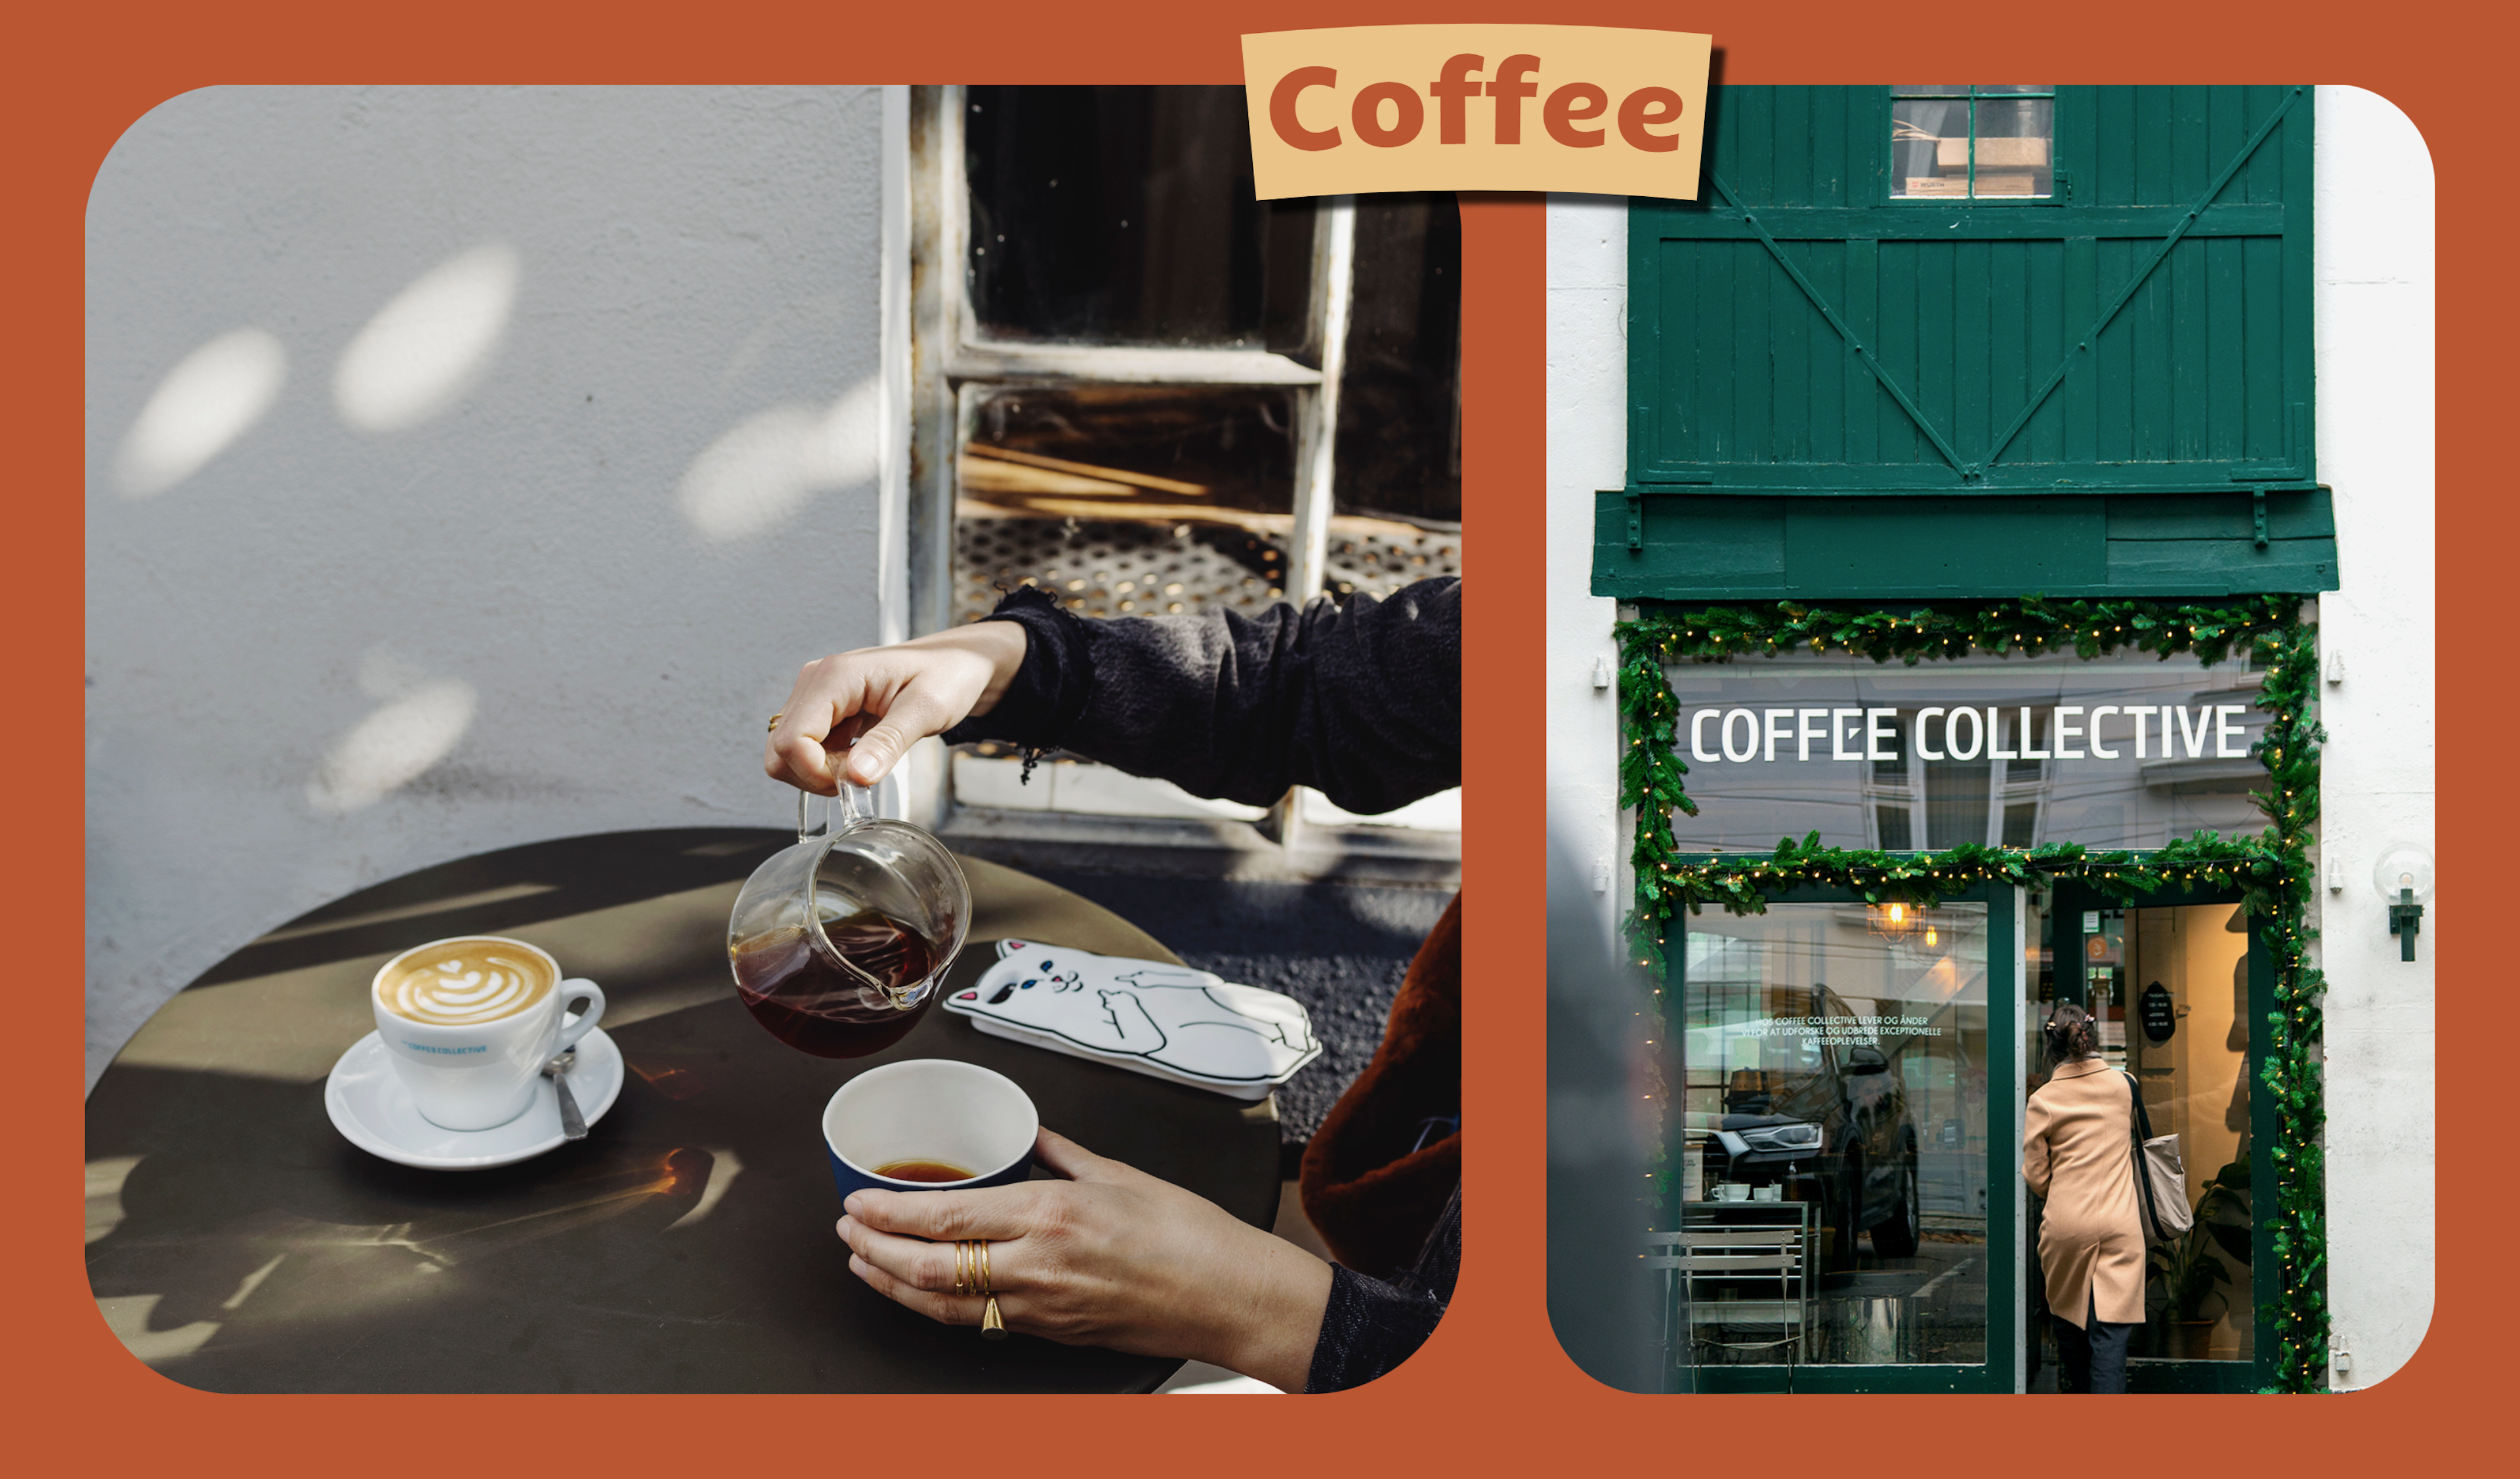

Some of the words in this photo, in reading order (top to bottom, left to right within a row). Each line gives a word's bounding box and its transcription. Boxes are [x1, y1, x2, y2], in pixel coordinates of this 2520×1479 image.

[1690, 707, 1899, 762] COFFEE
[1915, 705, 2247, 760] COLLECTIVE
[1775, 1017, 1805, 1026] COFFEE
[1807, 1016, 1857, 1025] COLLECTIVE
[1858, 1016, 1882, 1025] LEVER
[1883, 1016, 1898, 1025] OG
[1900, 1014, 1928, 1025] ÅNDER
[1751, 1028, 1768, 1036] FOR
[1769, 1028, 1780, 1036] AT
[1782, 1027, 1824, 1035] UDFORSKE
[1826, 1027, 1840, 1035] OG
[1841, 1026, 1878, 1035] UDBREDE
[1880, 1026, 1942, 1036] EXCEPTIONELLE
[1801, 1037, 1881, 1046] KAFFEEOPLEVELSER.
[437, 1045, 487, 1054] COLLECTIVE
